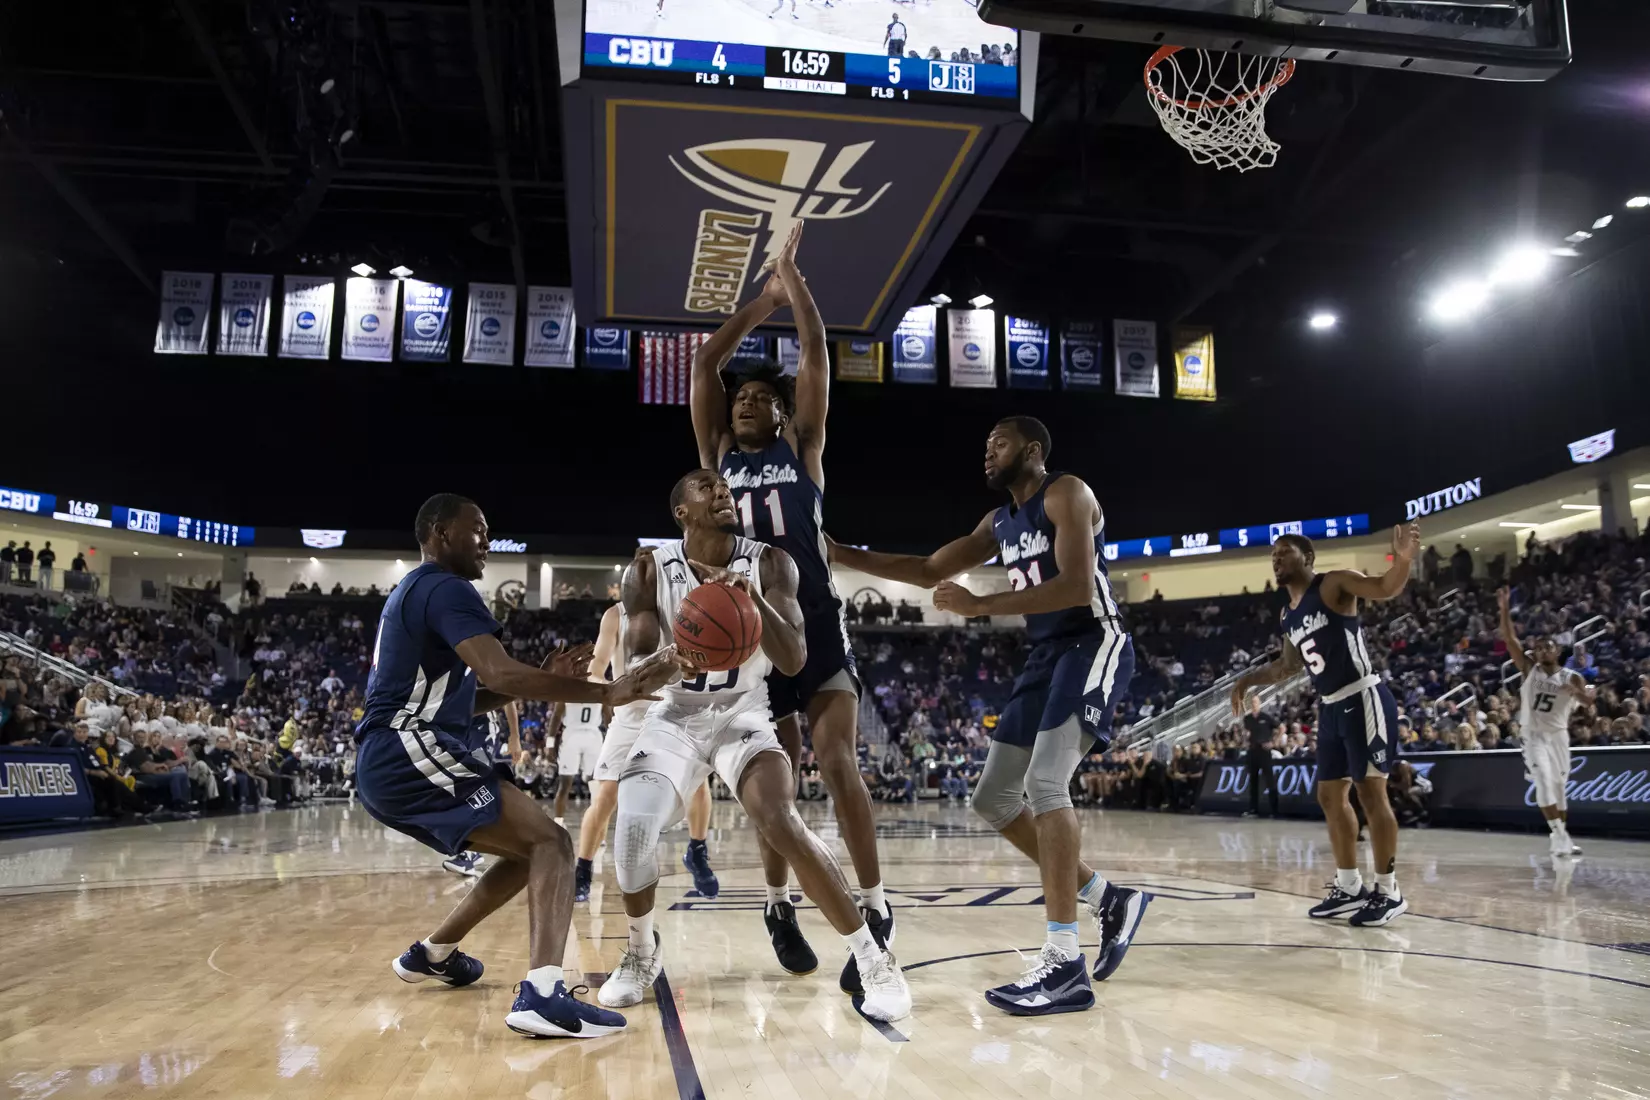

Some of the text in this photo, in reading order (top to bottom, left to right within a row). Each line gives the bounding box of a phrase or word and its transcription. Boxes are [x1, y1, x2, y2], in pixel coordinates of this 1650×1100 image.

[608, 37, 674, 67] CBU
[711, 43, 728, 71] 4
[782, 50, 830, 76] 16:59
[727, 74, 735, 86] 1
[888, 58, 902, 84] 5
[902, 88, 909, 100] 1
[684, 209, 763, 315] LANCERS
[762, 463, 798, 485] State
[0, 489, 41, 513] CBU
[67, 499, 99, 518] 16:59
[1405, 476, 1482, 521] DUTTON
[737, 489, 786, 539] 11
[1019, 529, 1050, 559] State
[1238, 528, 1249, 546] 5
[1300, 637, 1326, 676] 5
[580, 706, 592, 723] 0
[1533, 692, 1557, 713] 15
